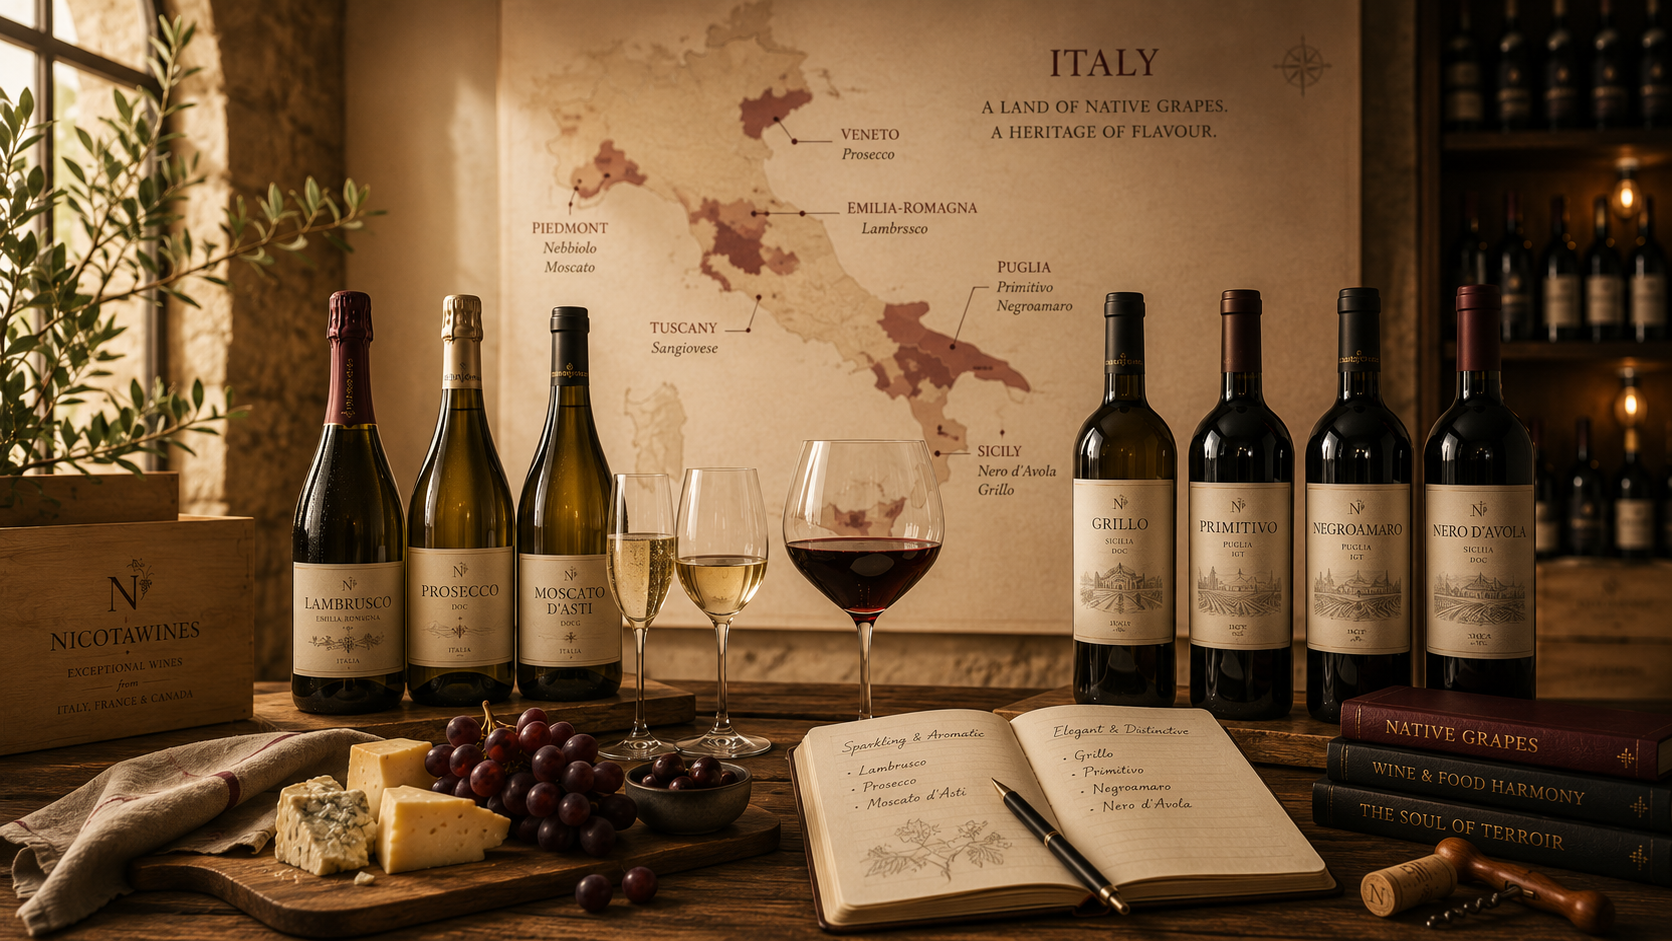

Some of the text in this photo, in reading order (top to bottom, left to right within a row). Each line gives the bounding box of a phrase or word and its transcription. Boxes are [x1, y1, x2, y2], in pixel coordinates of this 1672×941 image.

[1050, 48, 1159, 77] ITALY
[982, 99, 1228, 114] A LAND OF NATIVE GRAPES.
[841, 128, 900, 141] VENETO
[991, 125, 1217, 139] A HERITAGE OF FLAVOUR.
[842, 148, 895, 161] Prosecco
[847, 202, 978, 215] EMILIA-ROMAGNA
[532, 222, 608, 235] PIEDMONT
[862, 222, 928, 235] Lambrssco
[543, 242, 597, 255] Nebbiolo
[545, 261, 595, 274] Moscato
[997, 261, 1051, 273] PUGLIA
[996, 281, 1053, 293] Primitivo
[997, 300, 1073, 315] Negroamaro
[650, 322, 718, 335] TUSCANY
[651, 341, 718, 356] Sangiovese
[978, 445, 1022, 457] SICILY
[978, 465, 1057, 477] Nero d'Avola
[978, 483, 1015, 496] Grillo
[1092, 517, 1149, 531] GRILLO
[1200, 520, 1277, 534] PRIMITIVO
[1313, 522, 1403, 536] NEGROAMARO
[1433, 524, 1526, 539] NERO D'AVOLA
[421, 584, 499, 598] PROSECCO
[535, 586, 605, 599] MOSCATO
[305, 596, 392, 610] LAMBRUSCO
[547, 603, 593, 615] D'ASTI
[50, 621, 200, 651] NICOTAWINES
[67, 657, 183, 678] EXCEPTIONAL WINES
[116, 679, 139, 692] from
[94, 696, 137, 711] FRANCE
[140, 695, 148, 704] &
[151, 690, 193, 702] CANADA
[1054, 725, 1103, 739] Elegant
[1109, 725, 1119, 734] &
[1386, 719, 1538, 753] NATIVE GRAPES
[842, 729, 984, 756] Sparkling & Aromatic
[1074, 749, 1113, 762] Grillo
[858, 759, 927, 776] Lambrusco
[1083, 766, 1144, 777] Primitivo
[863, 778, 917, 792] Prosecco
[1093, 783, 1171, 796] Negroamaro
[1372, 761, 1585, 806] WINE & FOOD HARMONY
[867, 787, 967, 810] Moscato d'Asti
[1103, 801, 1135, 812] Nero
[1360, 803, 1564, 850] THE SOUL OF TERROIR
